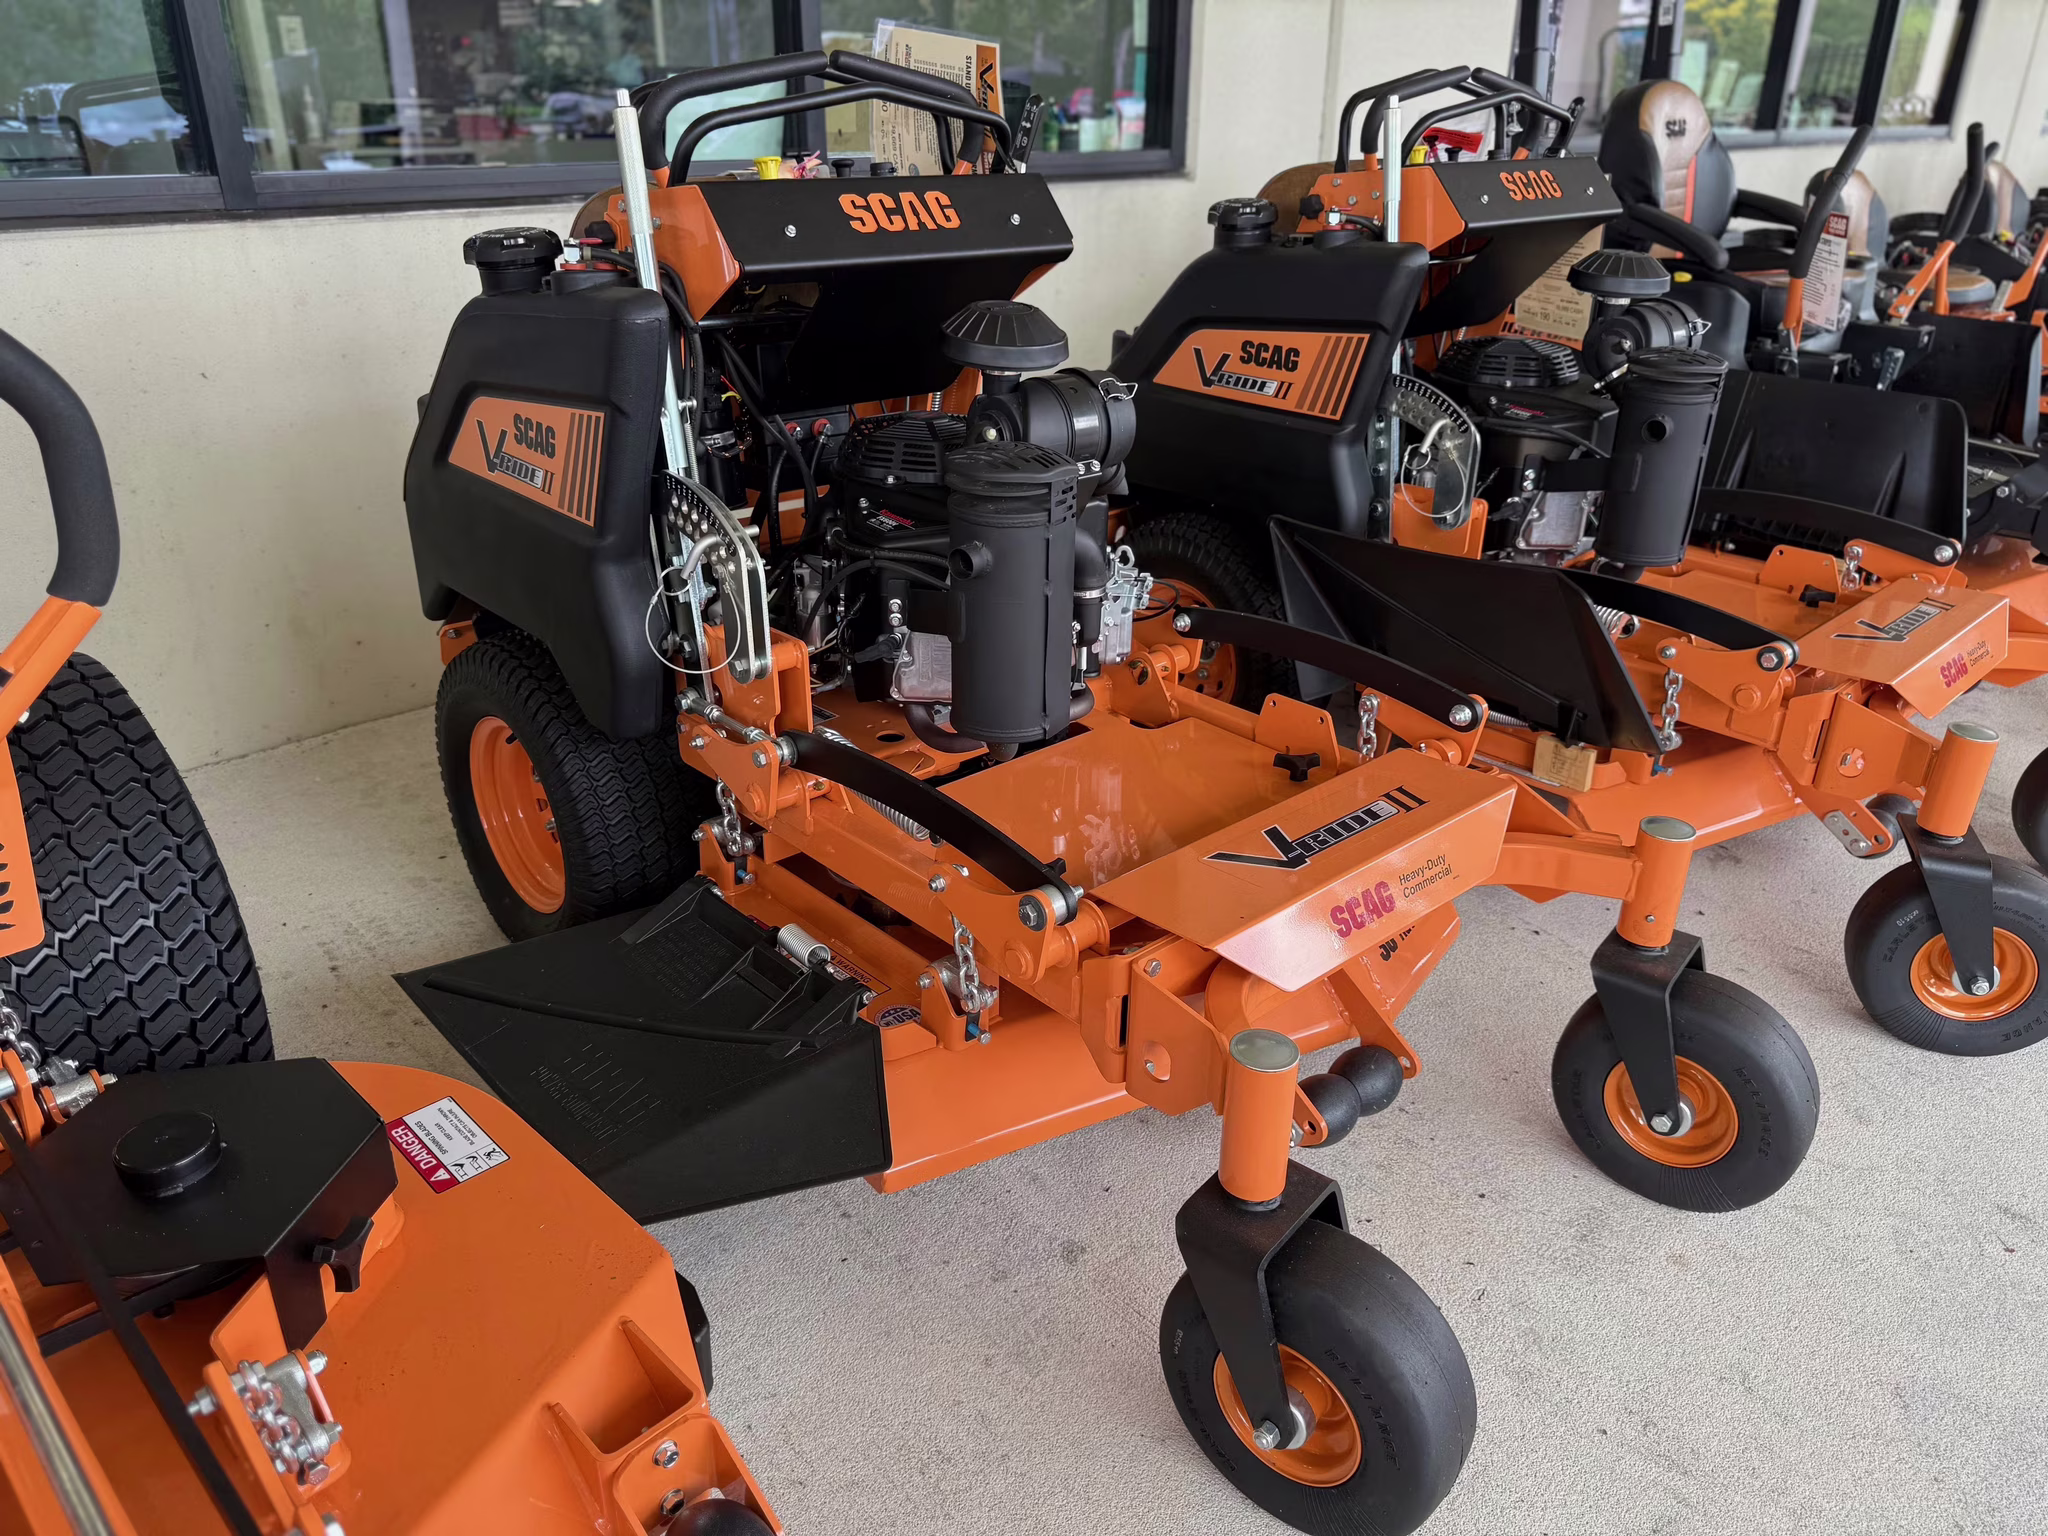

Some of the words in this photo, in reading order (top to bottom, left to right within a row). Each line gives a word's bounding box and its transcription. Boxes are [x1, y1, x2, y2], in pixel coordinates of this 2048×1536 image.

[1499, 169, 1563, 201] SCAG
[838, 190, 961, 234] SCAG
[1239, 340, 1300, 373] SCAG
[513, 413, 556, 459] SCAG
[1966, 640, 1988, 658] Heavy-Duty
[1969, 645, 1990, 668] Commercial
[1939, 653, 1969, 689] SCAG
[1398, 854, 1447, 886] Heavy-Duty
[1402, 863, 1453, 899] Commercial
[1329, 880, 1396, 939] SCAG
[836, 958, 872, 984] WARNING
[895, 1008, 922, 1024] USA
[437, 1107, 451, 1121] THROWN
[447, 1107, 459, 1121] INJURE
[457, 1117, 465, 1126] CAN
[414, 1120, 433, 1138] BLADES
[434, 1122, 446, 1134] CLEAR
[443, 1130, 453, 1141] KEEP
[450, 1120, 466, 1136] CONTACT
[462, 1133, 476, 1146] BLADE
[463, 1123, 478, 1139] OBJECTS
[391, 1125, 438, 1170] DANGER
[428, 1132, 449, 1155] SPINNING
